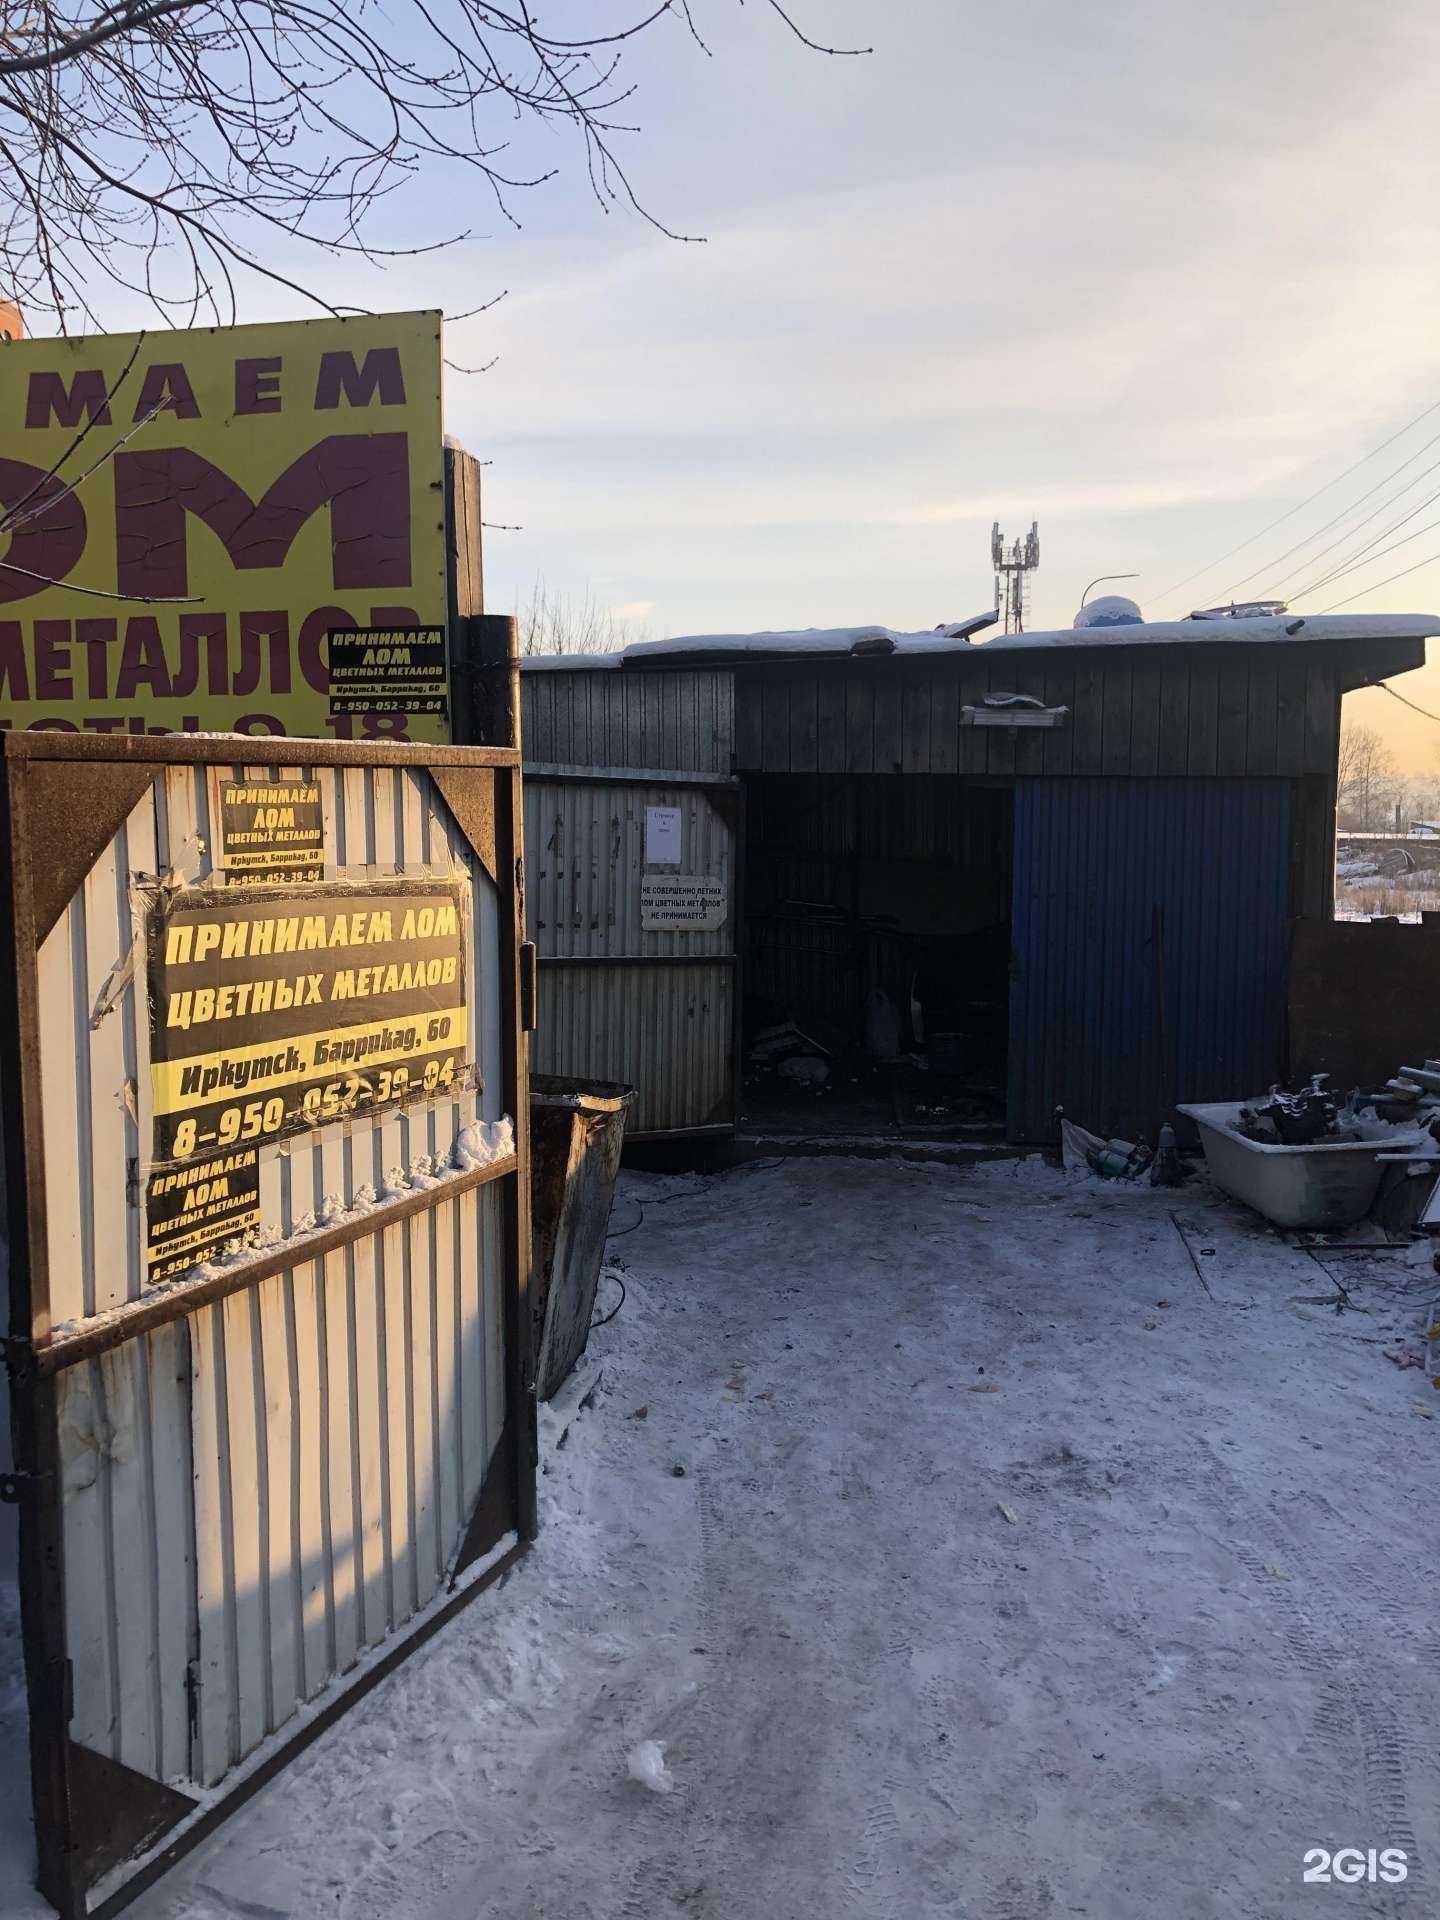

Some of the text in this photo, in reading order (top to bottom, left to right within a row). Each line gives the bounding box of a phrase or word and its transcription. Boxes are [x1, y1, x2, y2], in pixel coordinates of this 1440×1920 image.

[333, 632, 441, 646] ПРИНИМАЕМ
[0, 606, 420, 701] ЕТАЛЛО
[362, 648, 411, 665] ЛОМ
[333, 666, 442, 677] ЦВЕТНЫХ МЕТАЛЛОВ
[333, 701, 442, 711] 8-950-052-39-04
[225, 789, 319, 804] ПРИНИМАЕМ
[253, 807, 295, 829] ЛОМ
[227, 830, 320, 845] ЦВЕТНЫХ МЕТАЛЛОВ
[309, 851, 319, 860] 60
[655, 900, 686, 908] ЦВЕТНЫХ
[651, 912, 708, 920] НЕ ПРИНИМАЕТСЯ
[165, 906, 457, 965] ПРИНИМАЕМ ЛОМ
[166, 956, 457, 1031] ЦВЕТНЫХ МЕТАЛЛОВ
[180, 1016, 451, 1097] Иркутск, Баррикад, 60
[152, 1150, 256, 1196] ПРИНИМАЕМ
[182, 1177, 229, 1212] ЛОМ
[151, 1190, 257, 1237] ЦВЕТНЫХ МЕТАЛЛОВ
[244, 1213, 255, 1223] 60
